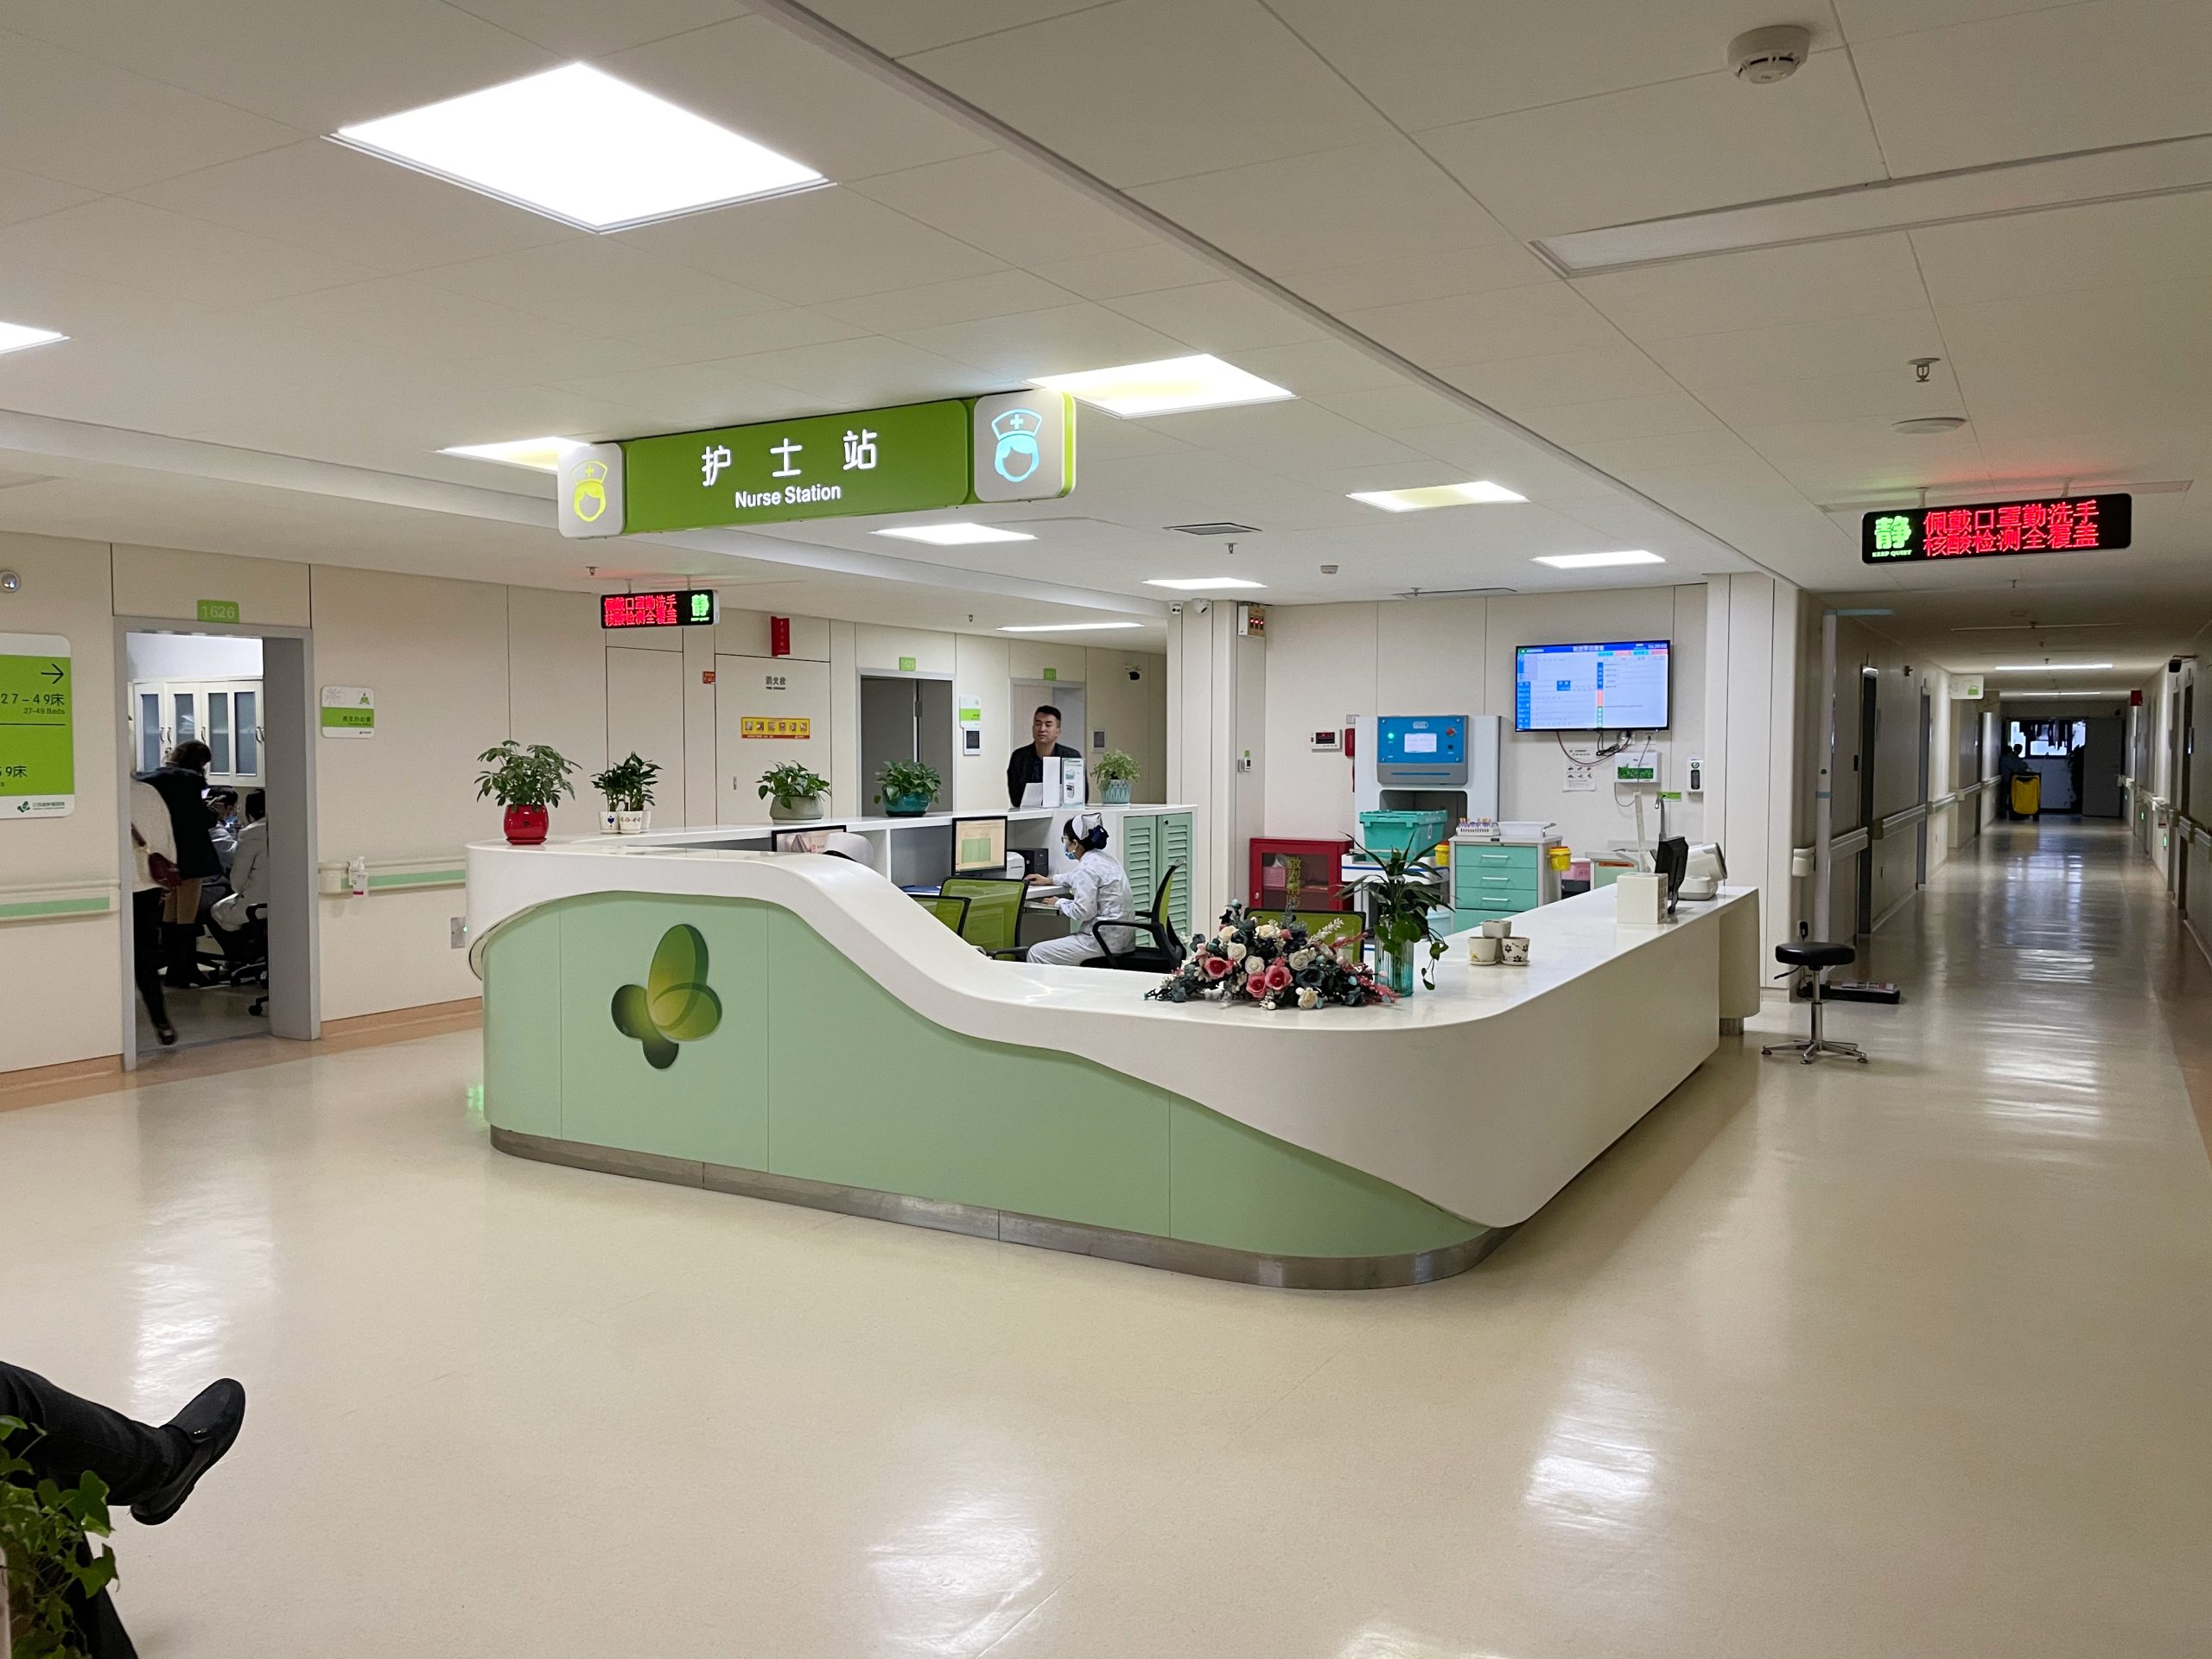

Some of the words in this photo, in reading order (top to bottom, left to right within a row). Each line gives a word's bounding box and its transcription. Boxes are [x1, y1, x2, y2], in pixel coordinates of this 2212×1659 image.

[701, 429, 877, 486] 护士站
[734, 491, 781, 508] Nurse
[785, 484, 842, 504] Station
[1874, 515, 1912, 550] 静
[1923, 499, 2100, 536] 佩戴口罩勤洗手
[1923, 522, 2100, 556] 核酸检测全覆盖
[200, 606, 235, 620] 1626
